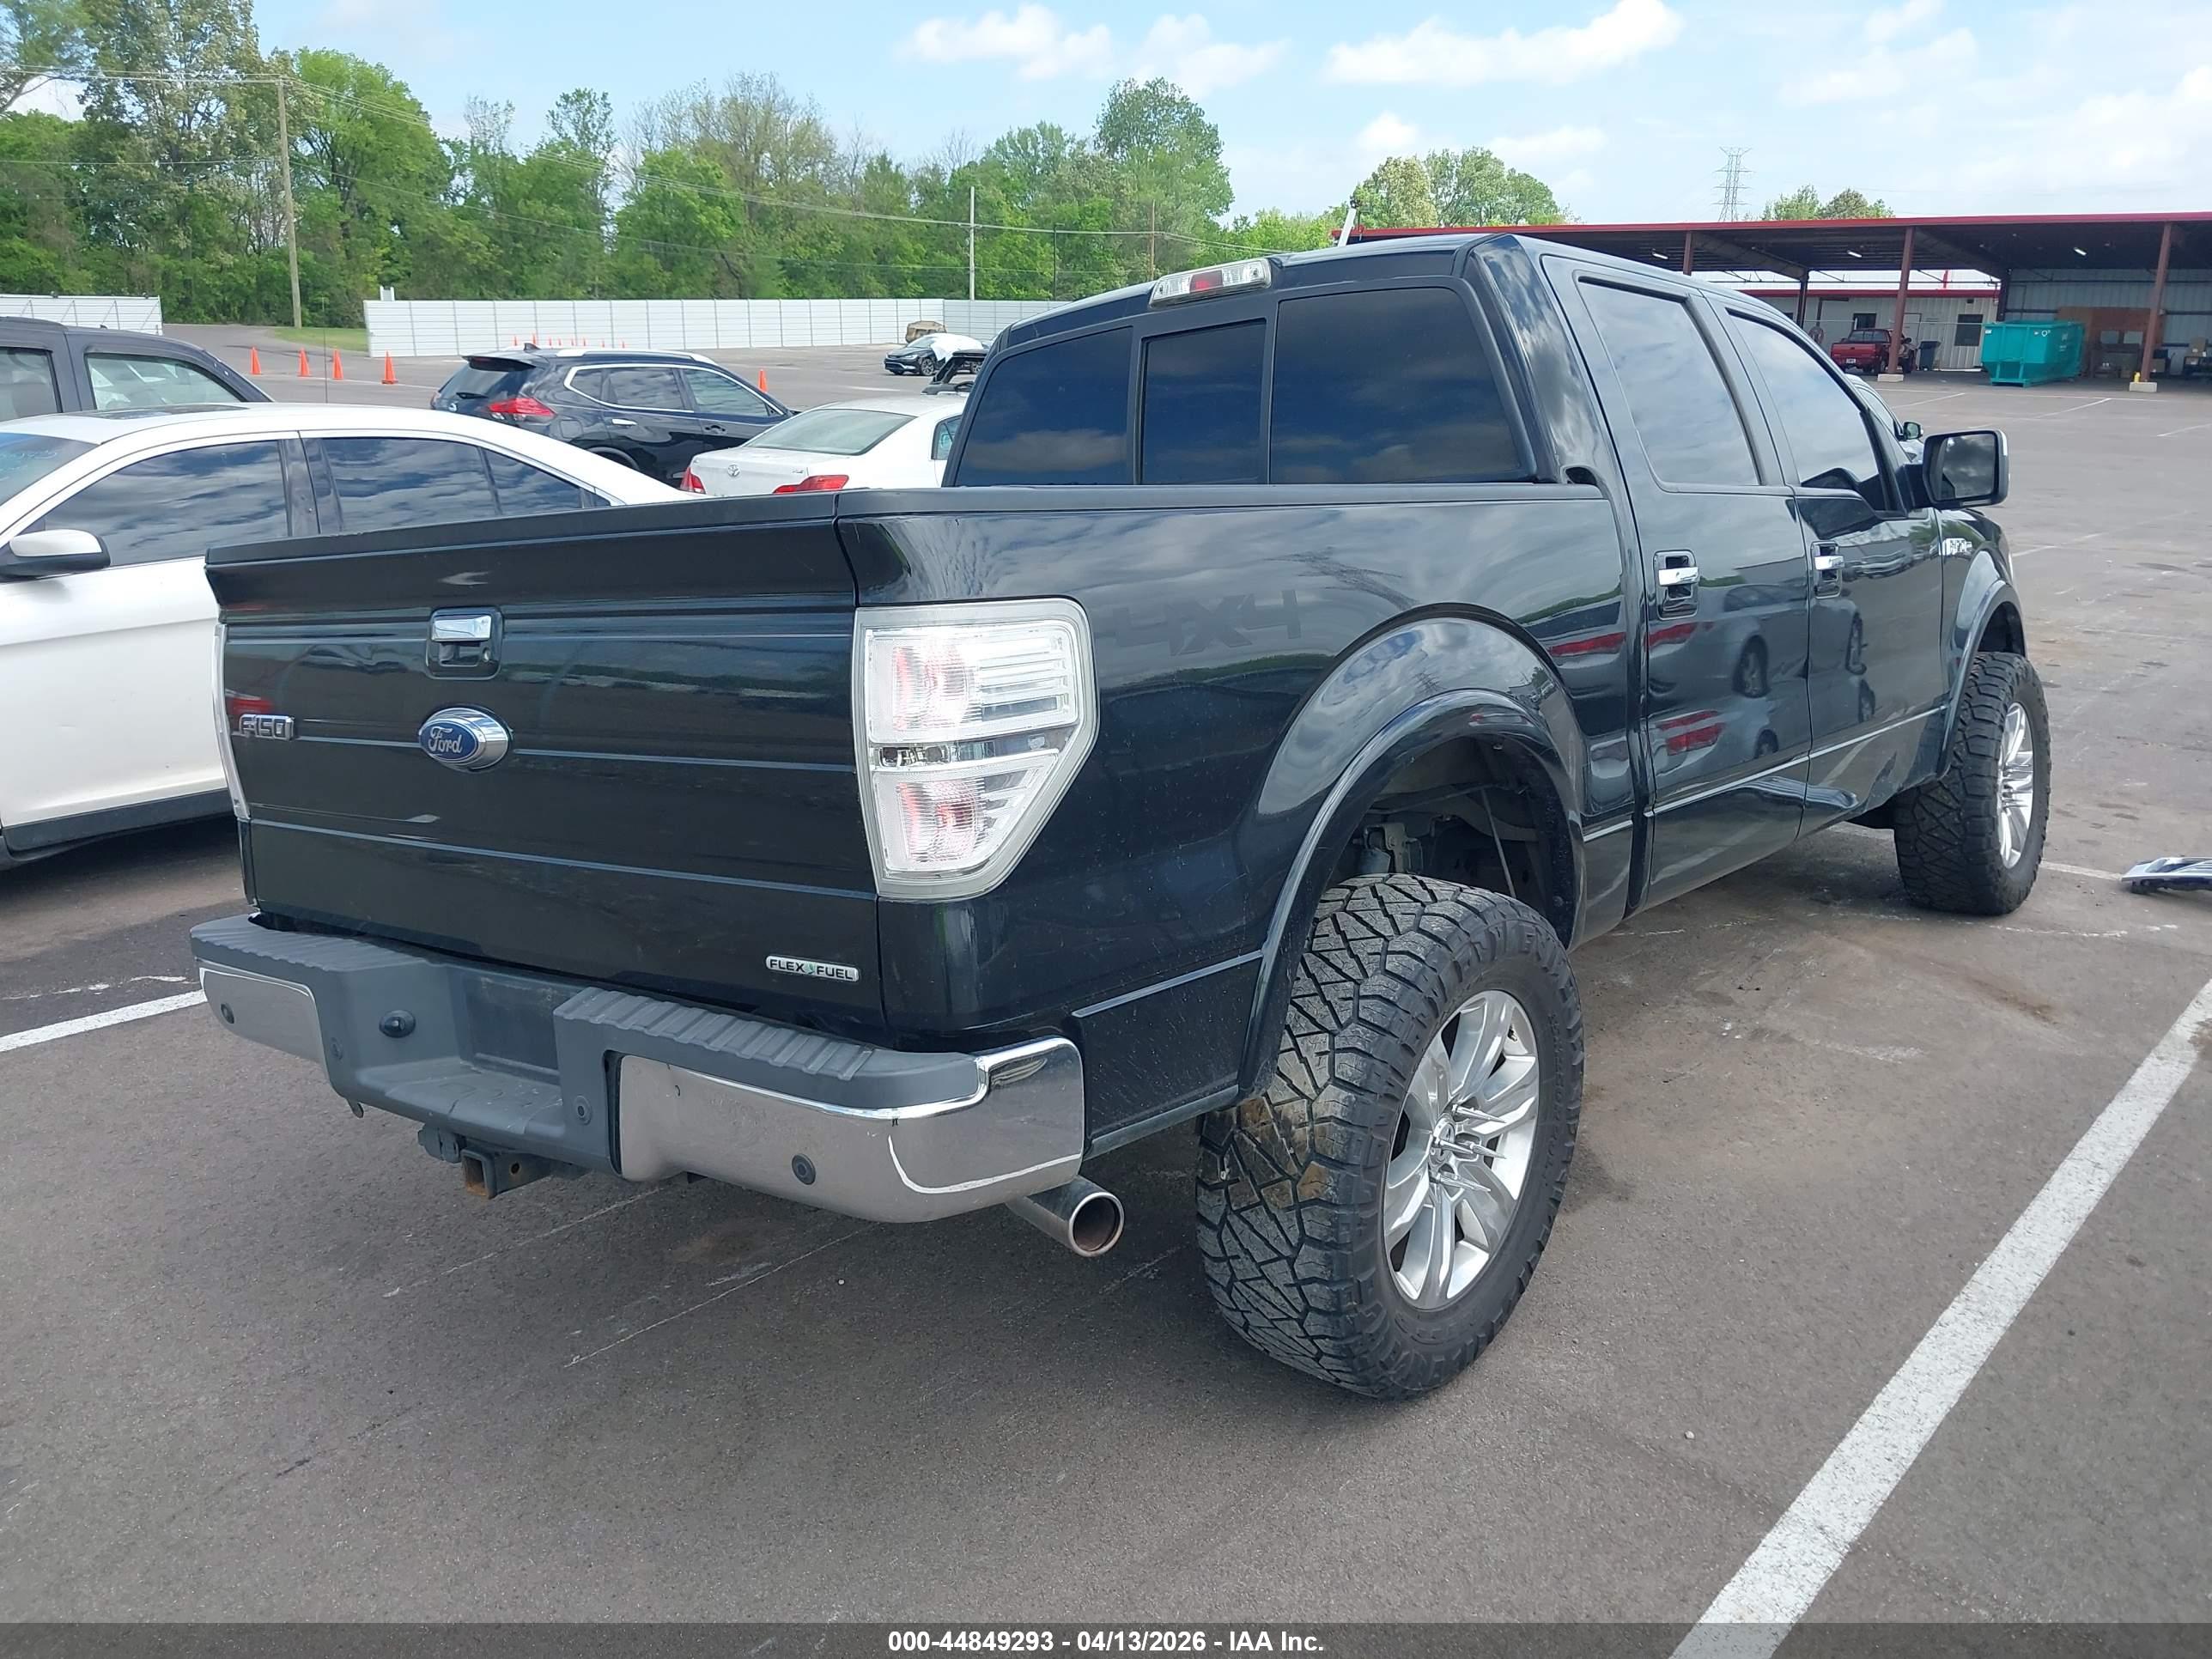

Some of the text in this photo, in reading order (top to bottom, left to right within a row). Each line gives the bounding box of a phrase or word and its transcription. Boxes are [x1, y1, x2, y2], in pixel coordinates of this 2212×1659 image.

[429, 725, 464, 754] Ford
[769, 958, 854, 980] FLEX FUEL
